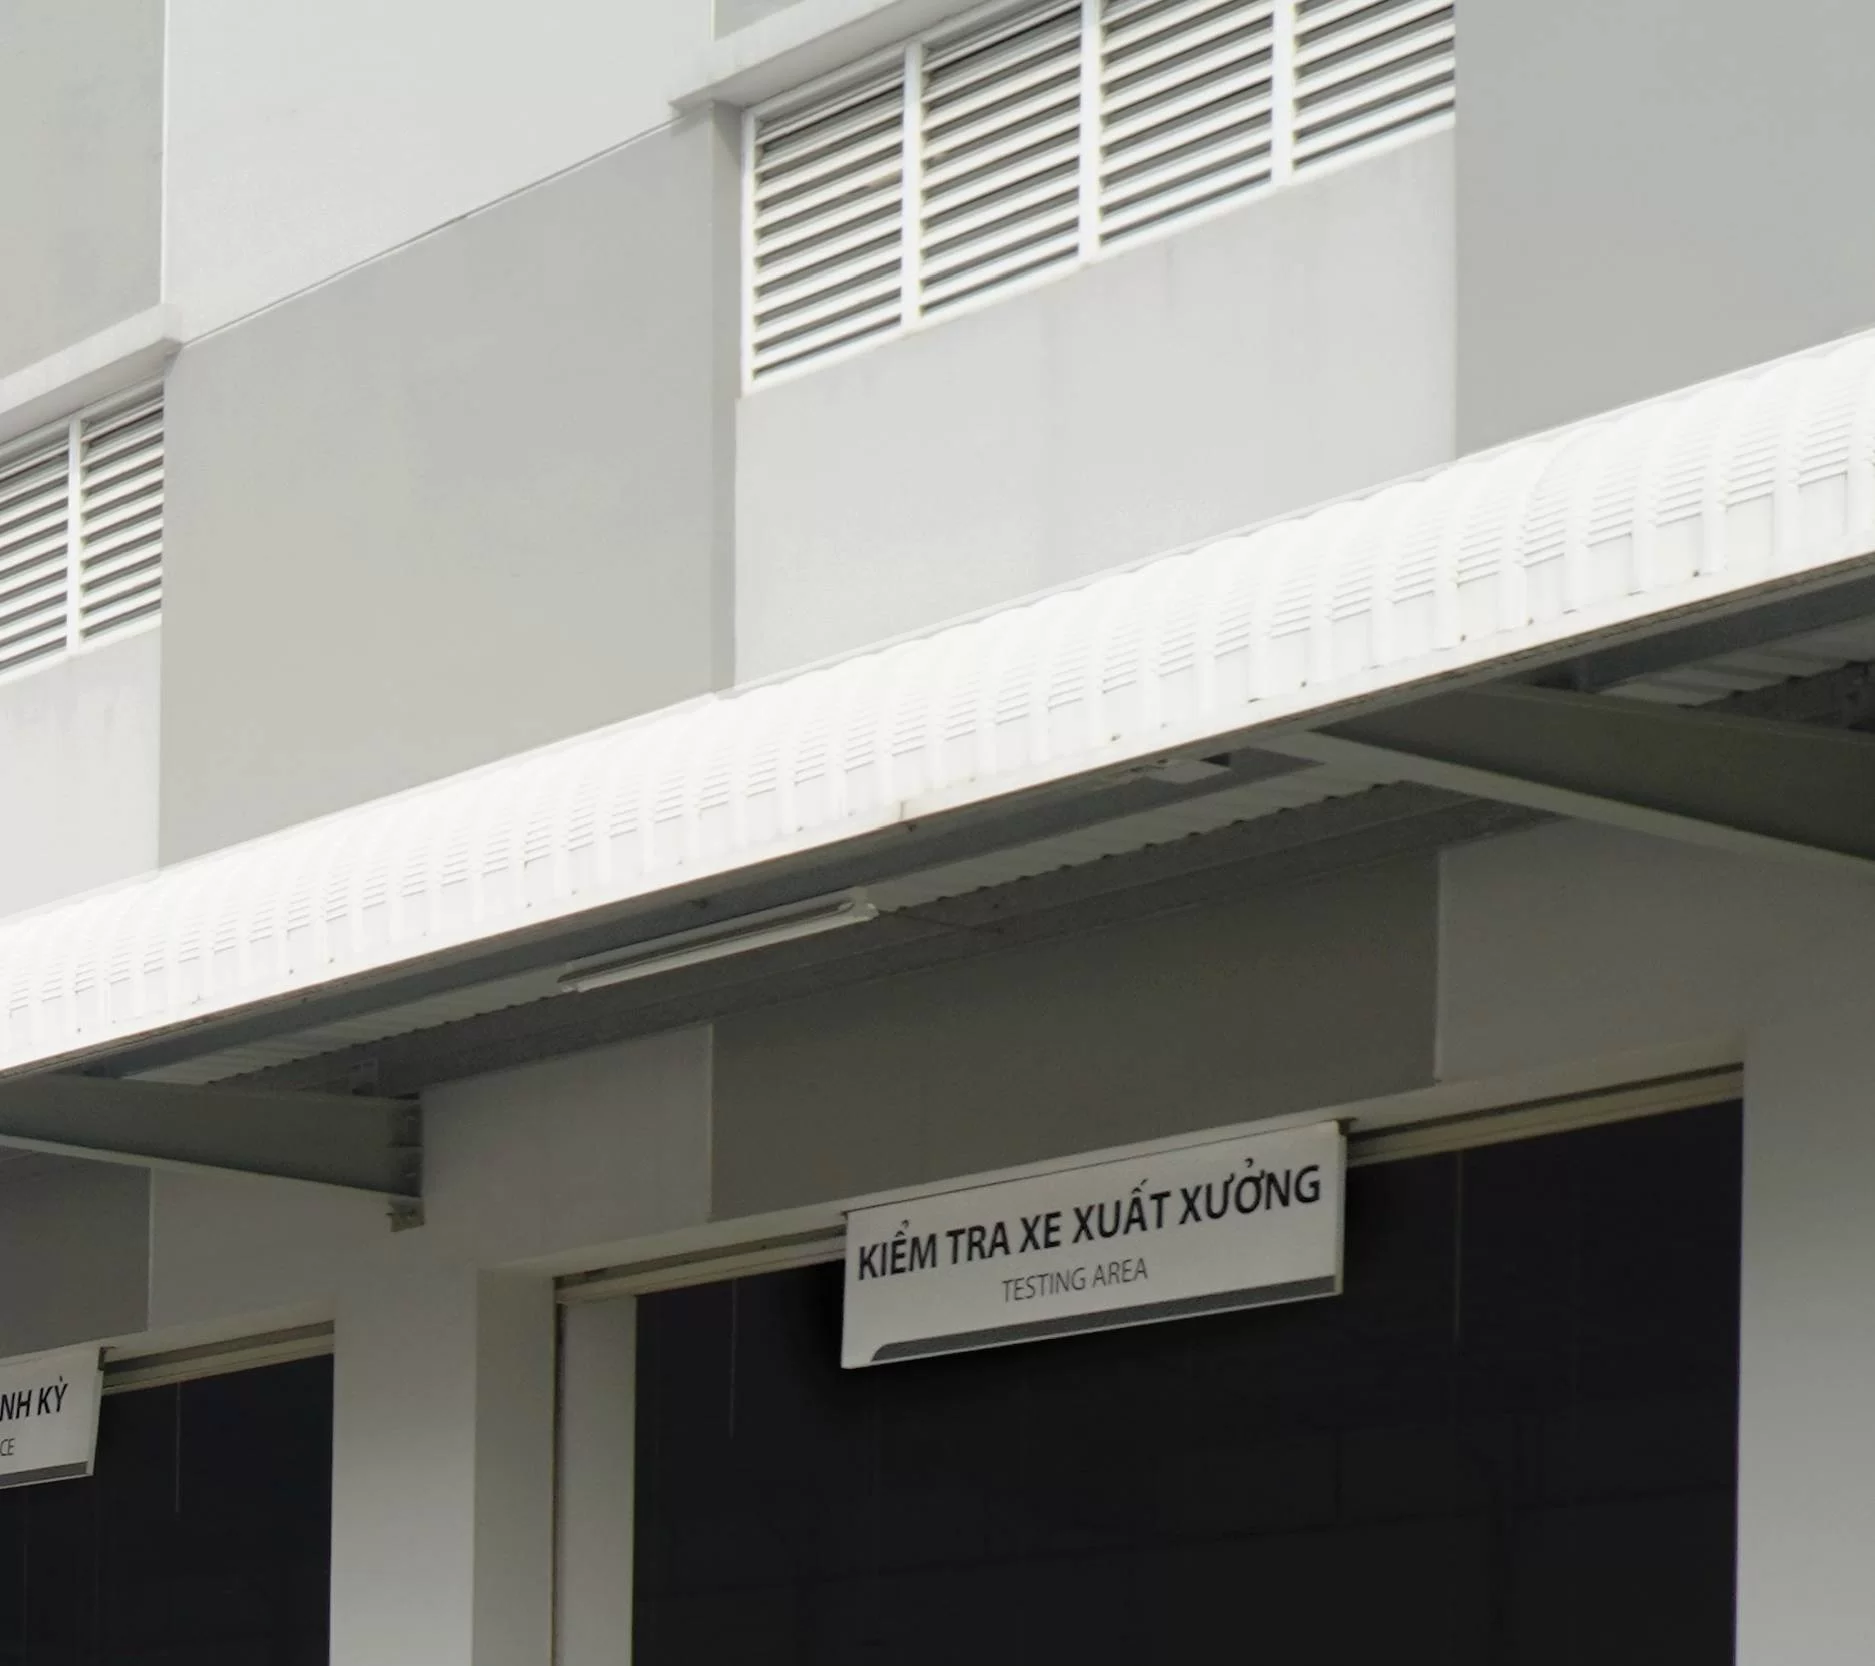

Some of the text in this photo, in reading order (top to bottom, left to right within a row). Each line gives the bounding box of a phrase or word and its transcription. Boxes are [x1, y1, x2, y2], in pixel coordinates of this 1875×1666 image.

[857, 1158, 1322, 1281] KIỂM TRA XE XUẤT XƯỞNG
[1002, 1257, 1149, 1303] TESTING AREA
